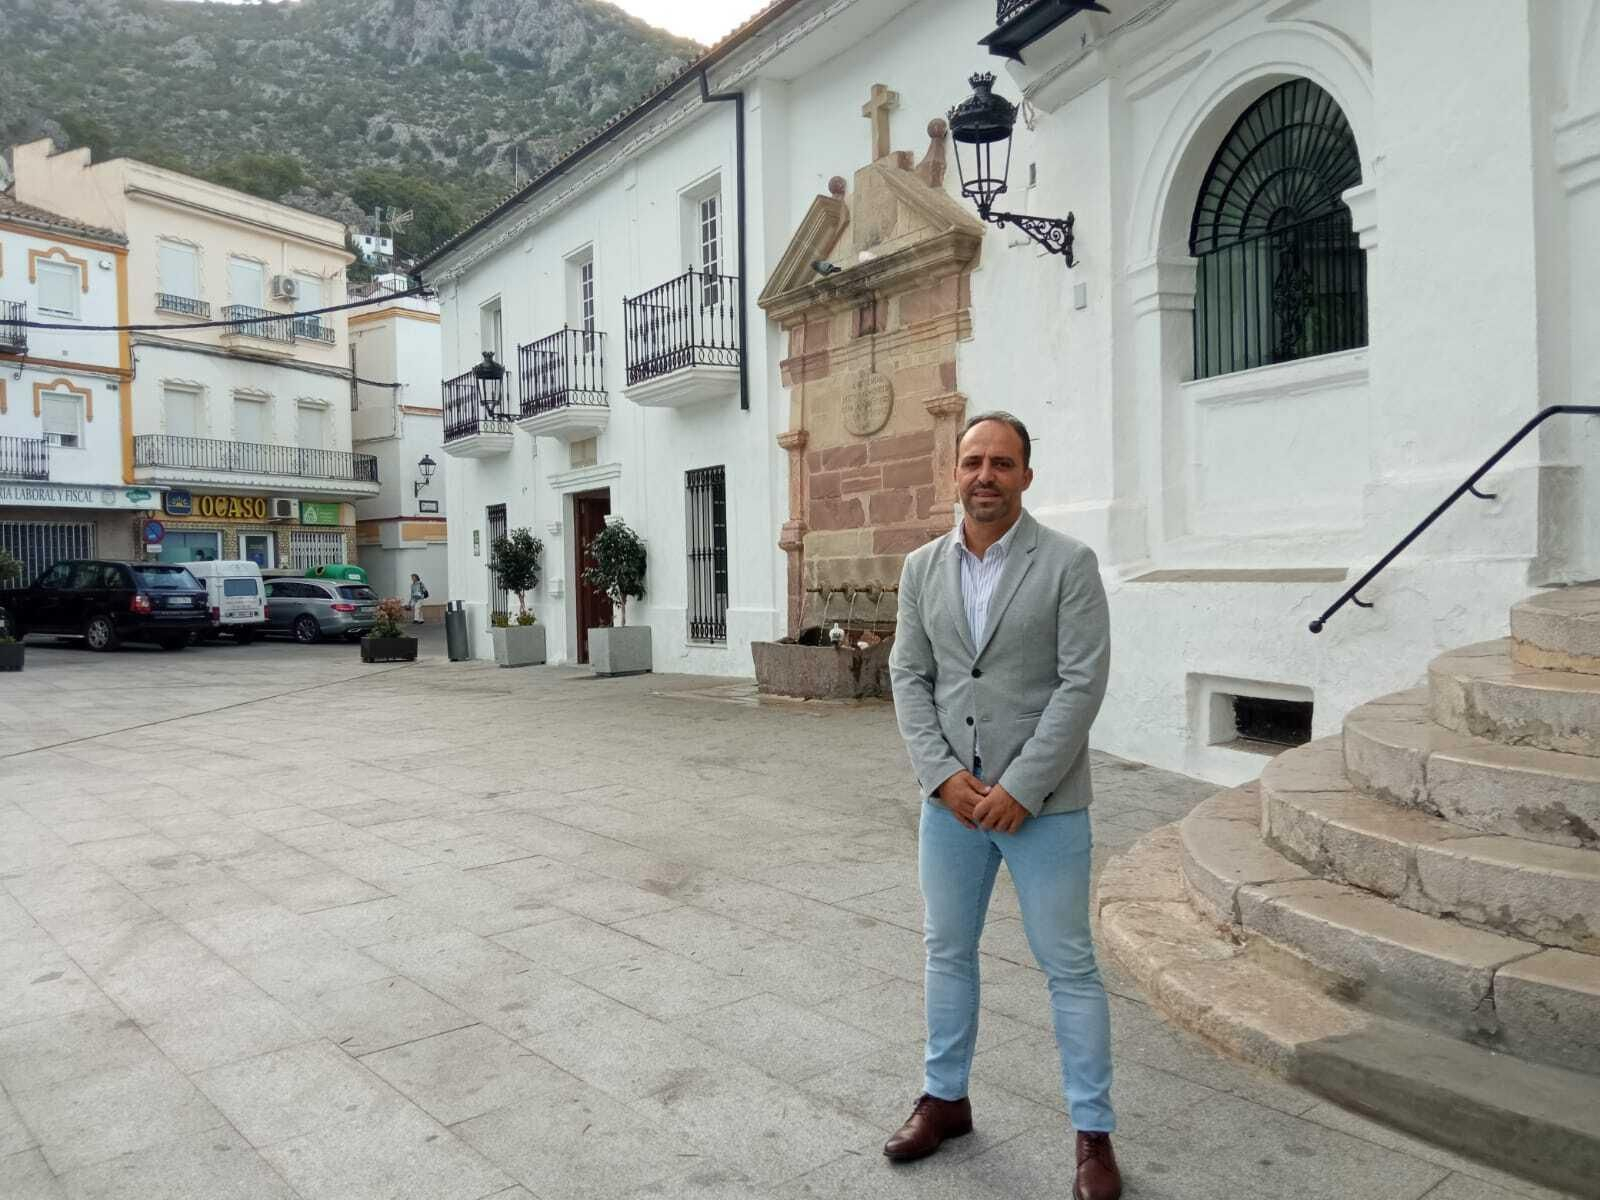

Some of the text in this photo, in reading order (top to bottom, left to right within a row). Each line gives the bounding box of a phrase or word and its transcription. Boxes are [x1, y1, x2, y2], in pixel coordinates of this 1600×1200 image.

[14, 487, 56, 501] LABORAL
[56, 487, 64, 501] Y
[65, 487, 95, 502] FISCAL
[202, 495, 266, 519] OCASO
